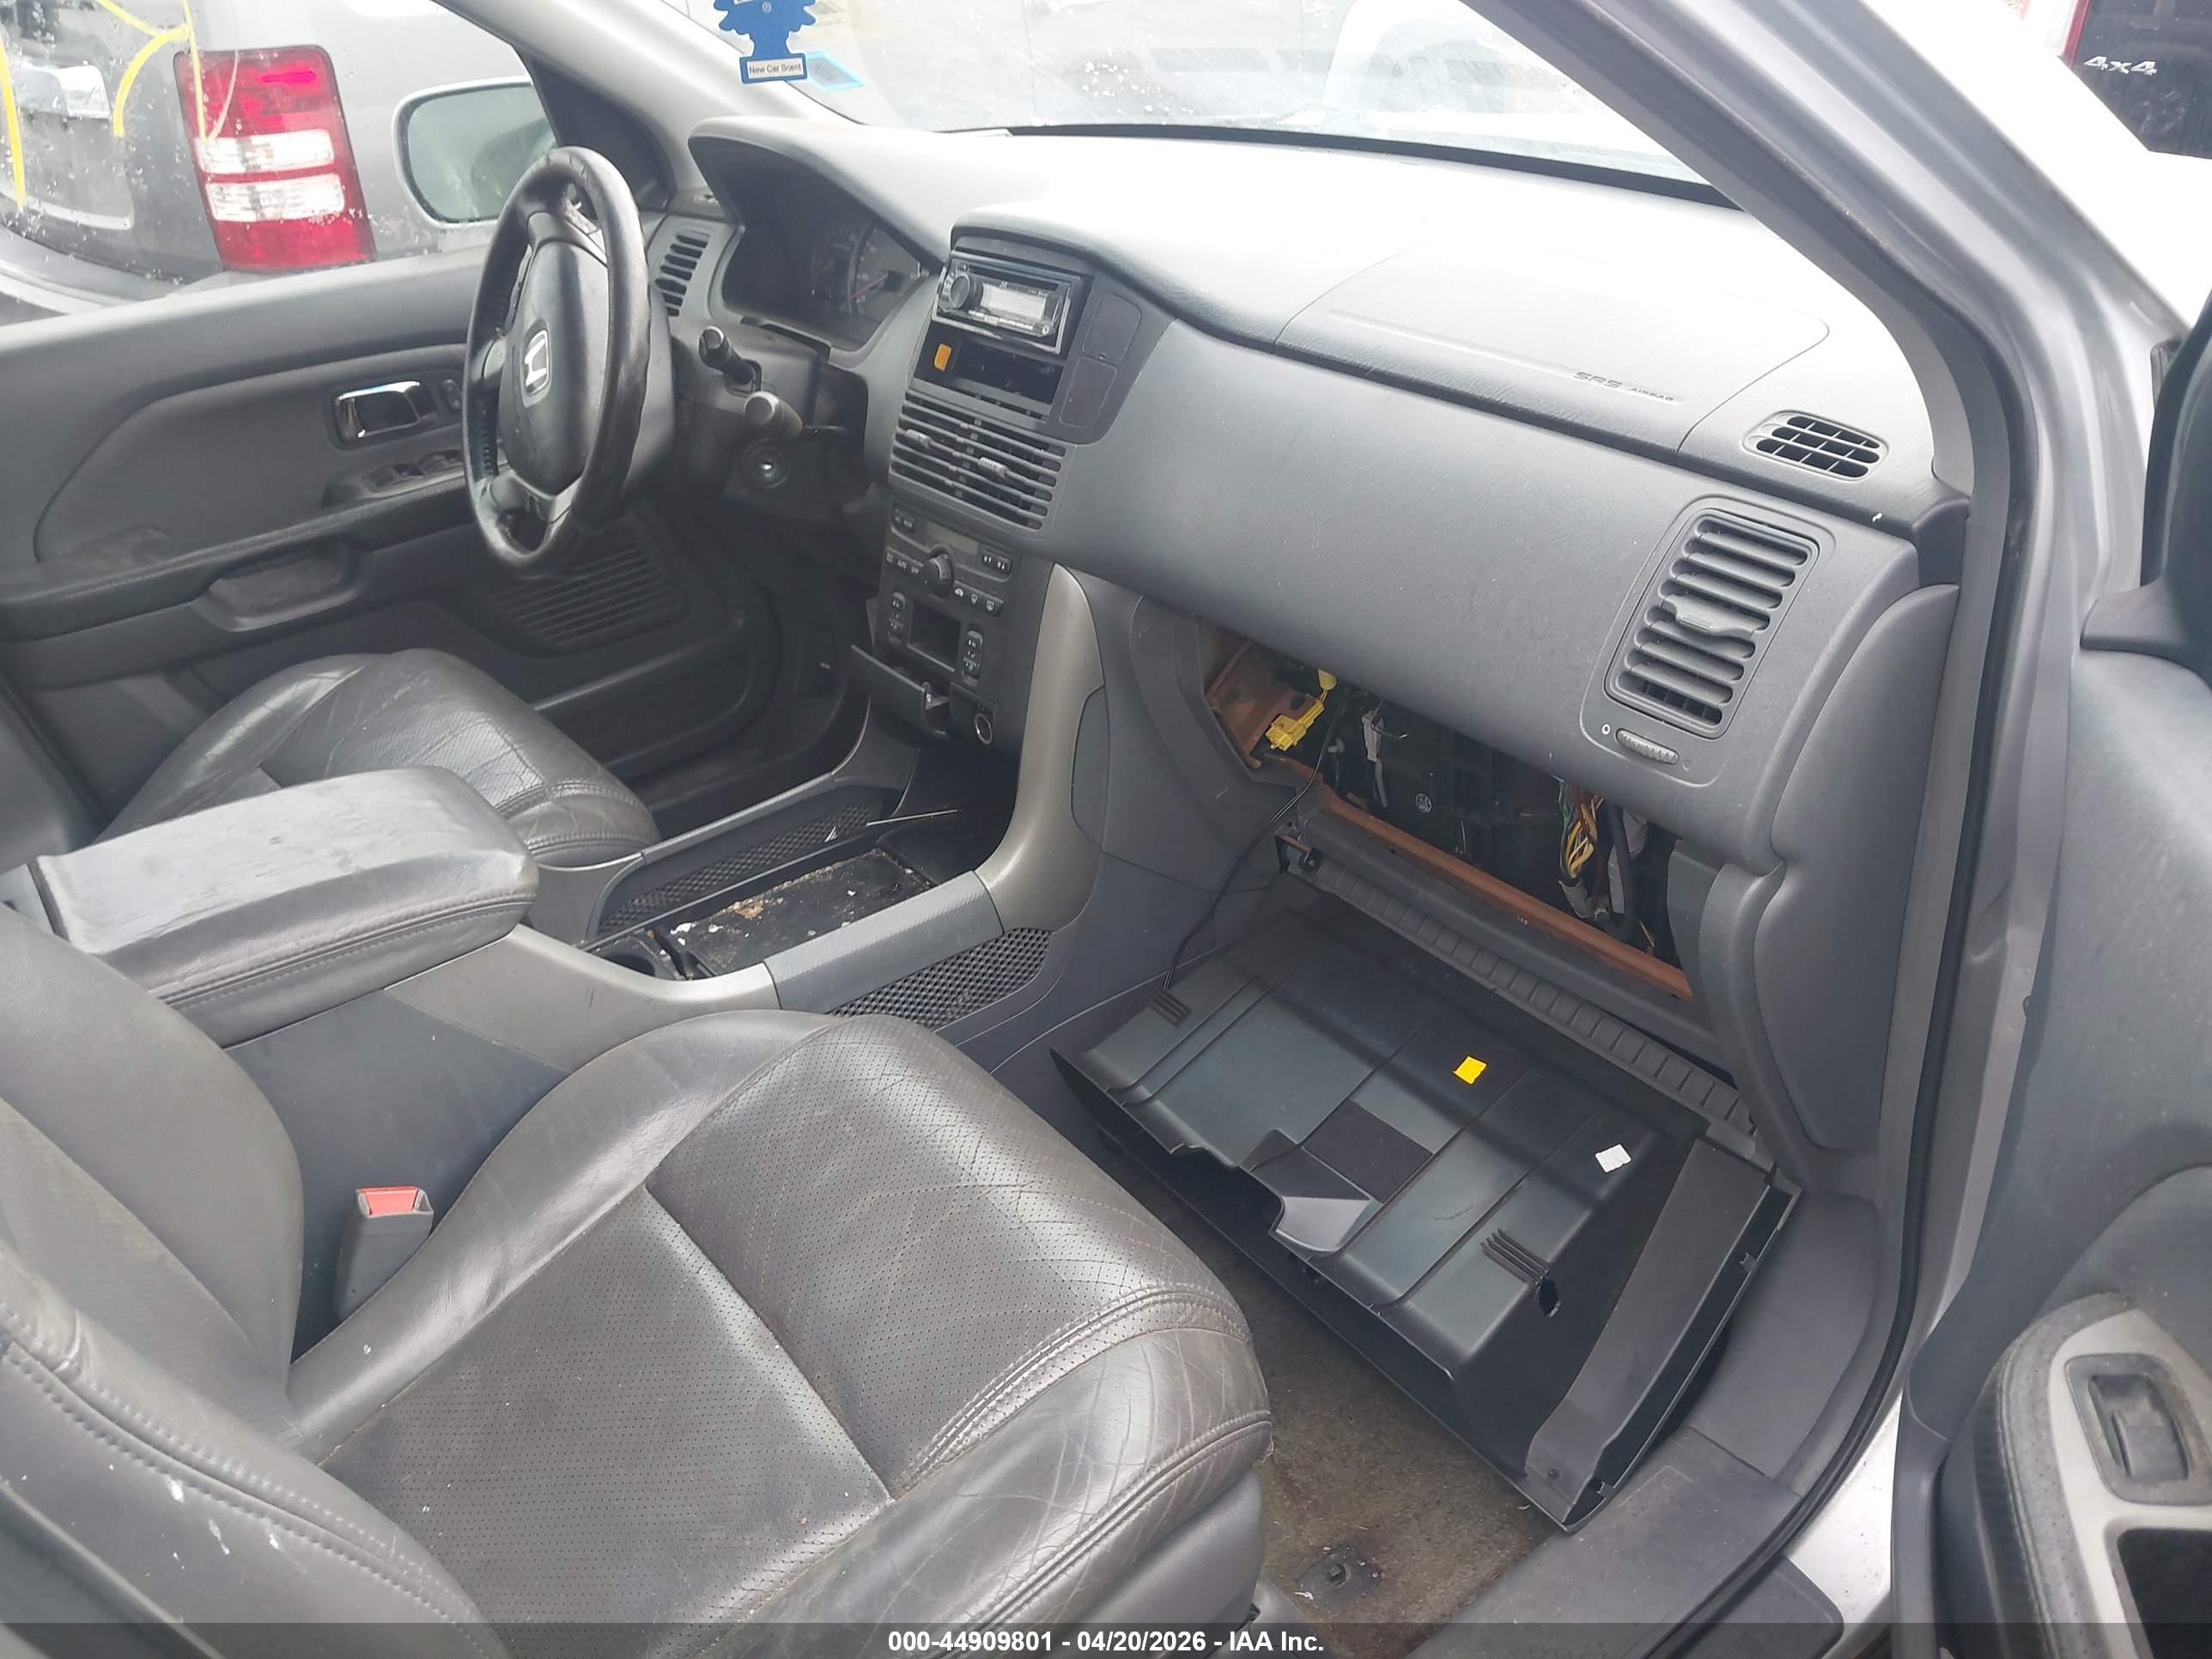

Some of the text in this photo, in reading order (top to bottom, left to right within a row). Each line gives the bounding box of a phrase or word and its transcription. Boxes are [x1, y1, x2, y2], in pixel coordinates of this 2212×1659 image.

[749, 65, 765, 74] New
[767, 64, 780, 73] Car
[1573, 372, 1674, 402] SRS AIRBAG
